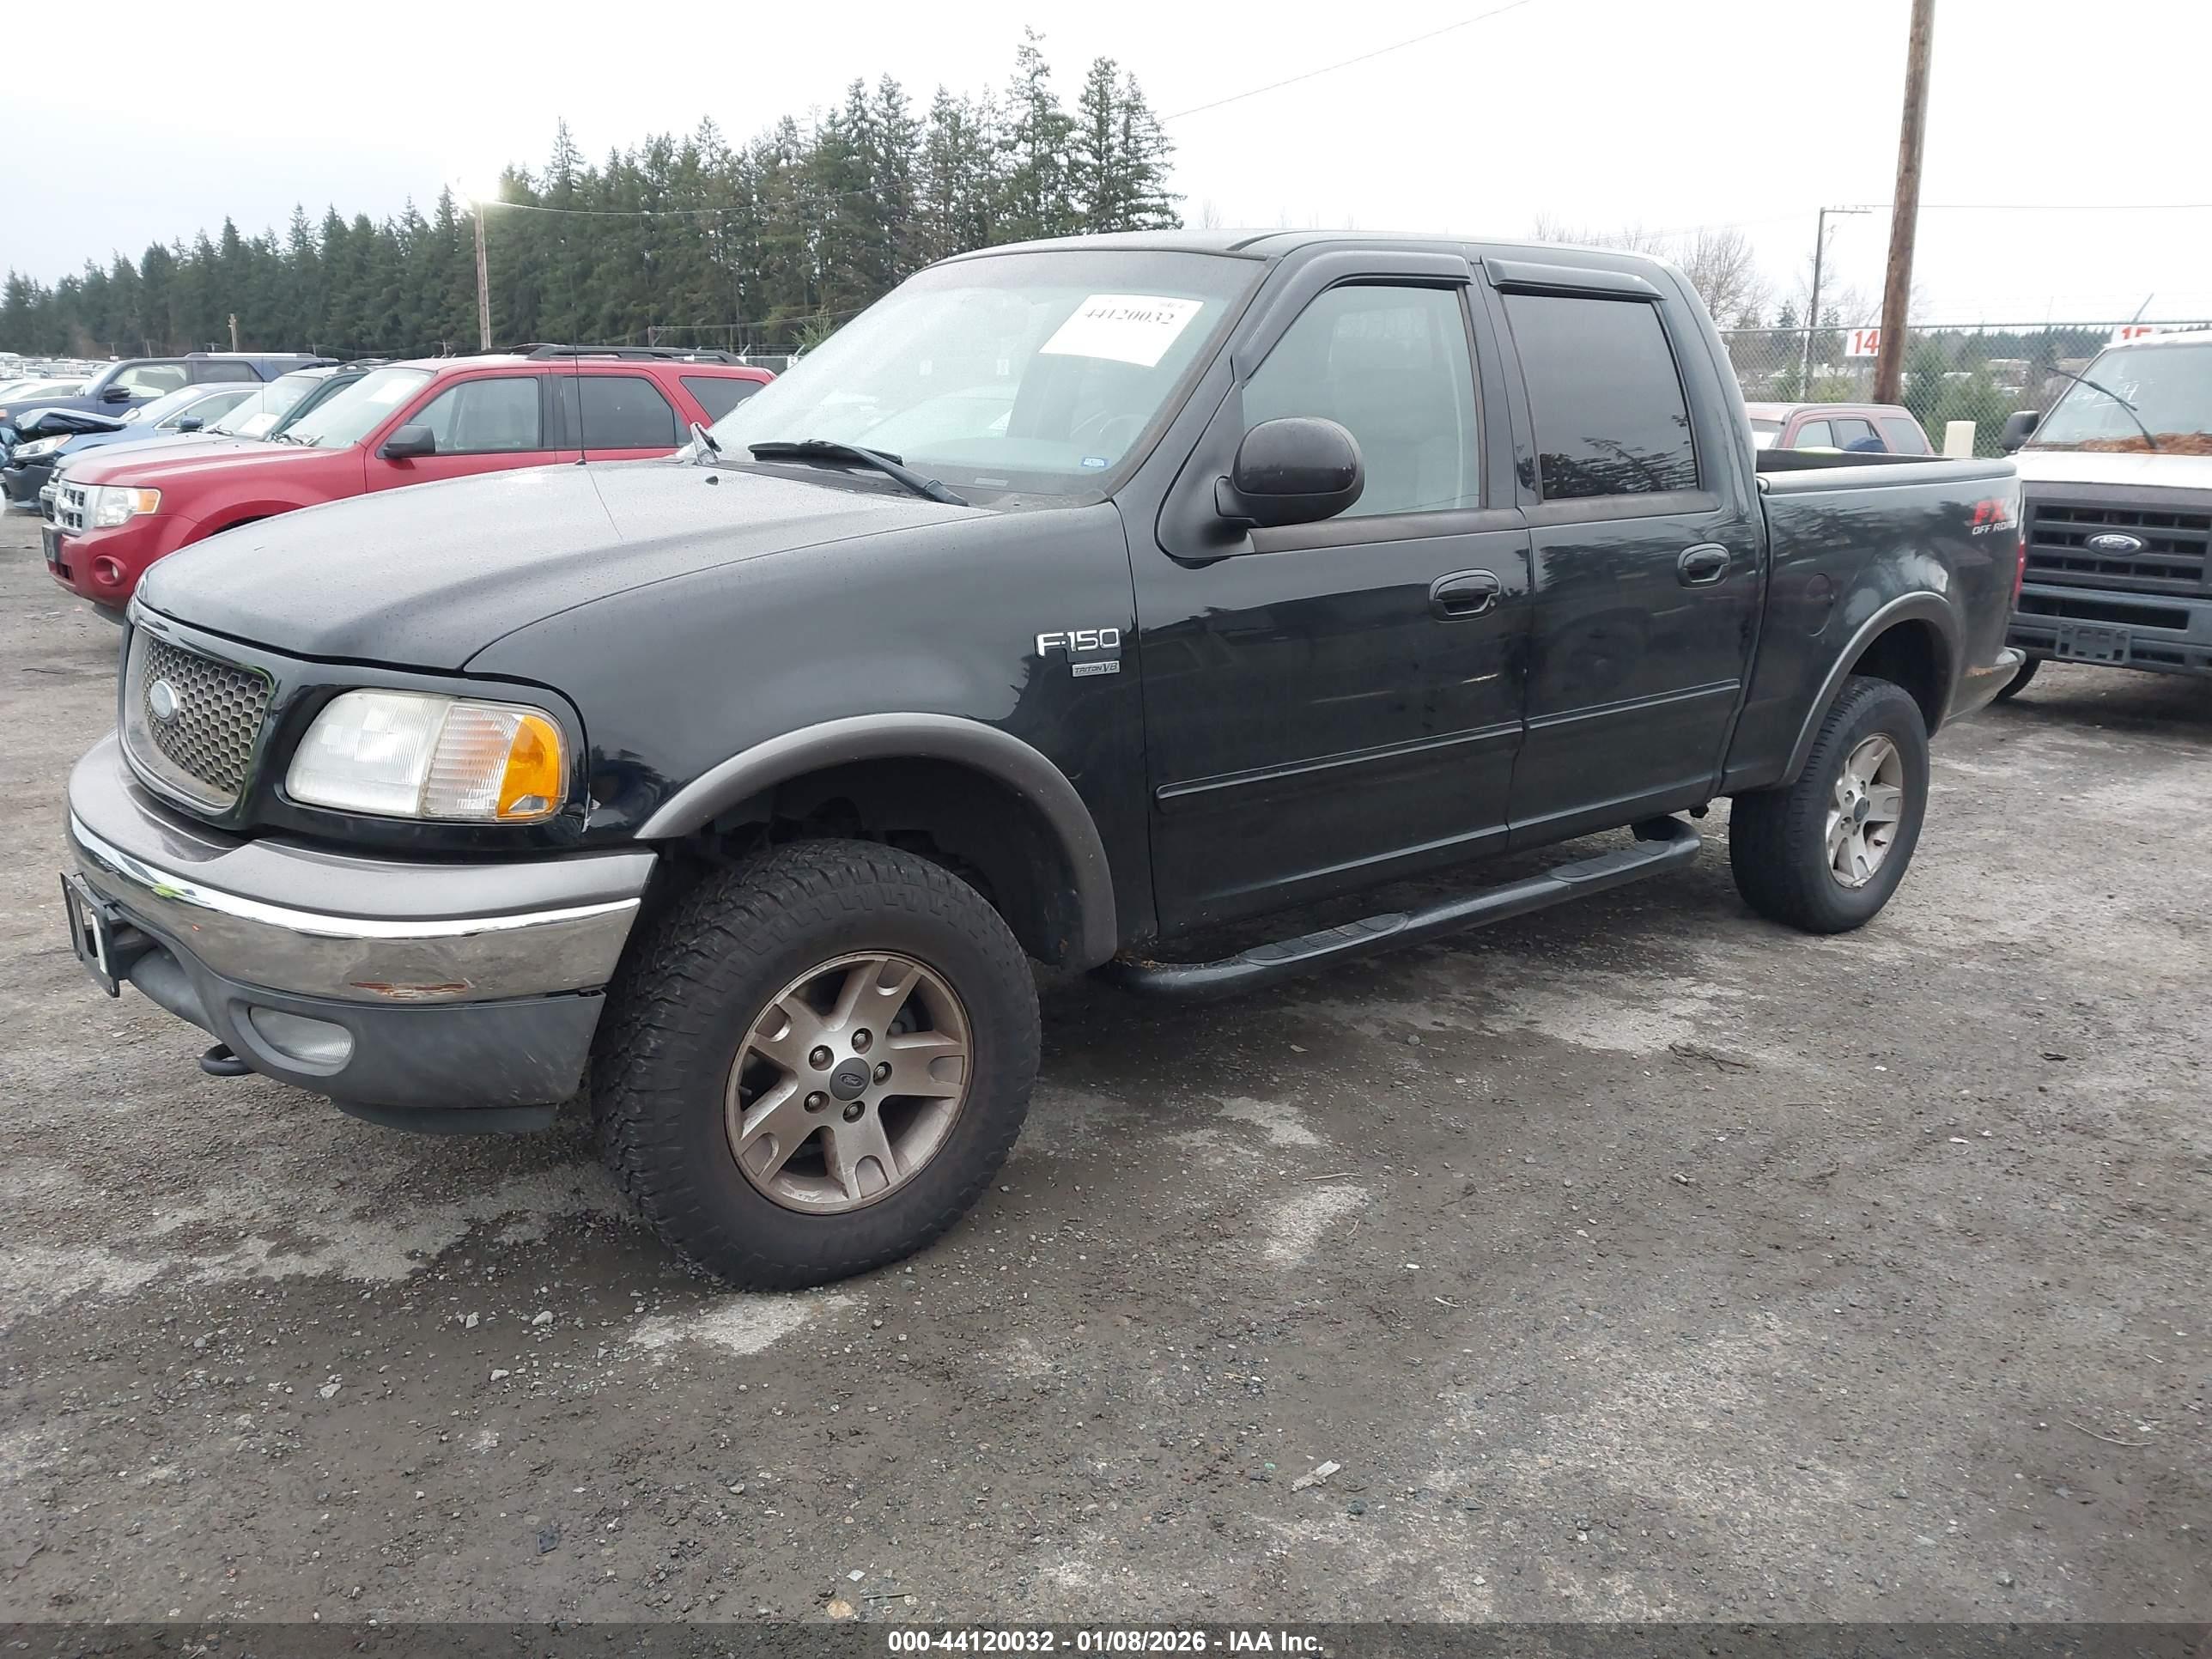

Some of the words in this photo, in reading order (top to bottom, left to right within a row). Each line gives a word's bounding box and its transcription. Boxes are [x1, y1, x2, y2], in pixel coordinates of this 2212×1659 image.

[1085, 308, 1175, 325] 44120032
[1855, 330, 1880, 354] 14
[1972, 524, 1992, 535] OFF
[1036, 628, 1120, 657] F-150
[1073, 665, 1103, 674] TRITON
[1103, 662, 1118, 672] V8
